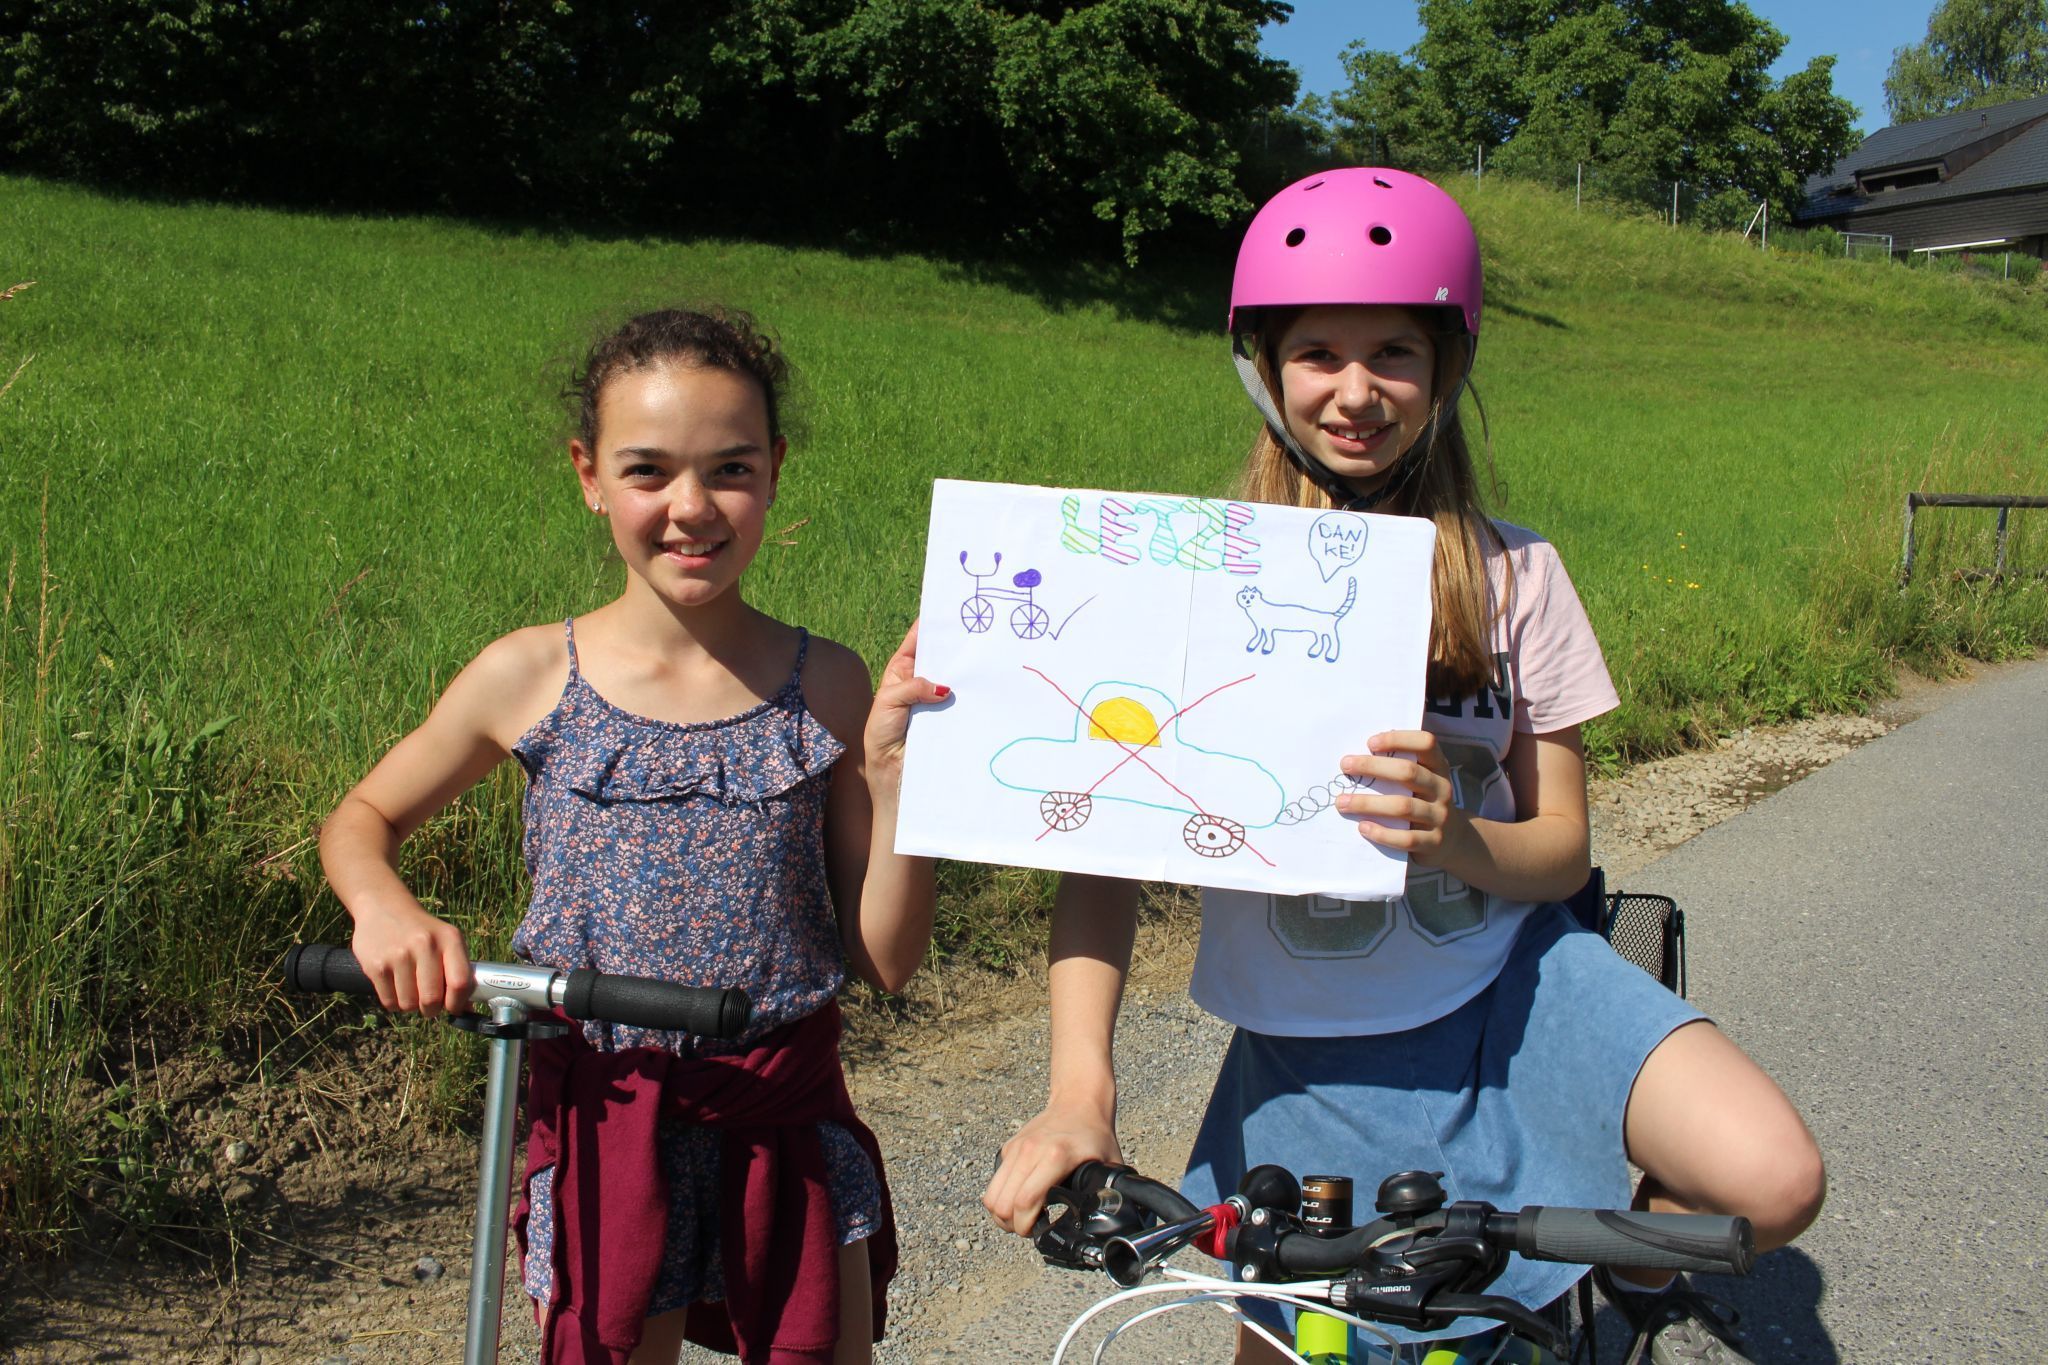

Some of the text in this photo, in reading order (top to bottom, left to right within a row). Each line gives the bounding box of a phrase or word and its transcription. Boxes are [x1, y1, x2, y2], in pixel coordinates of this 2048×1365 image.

[1434, 286, 1449, 301] K2
[1061, 494, 1263, 577] LETZE
[1318, 522, 1362, 542] DAN
[1324, 542, 1355, 560] KE!
